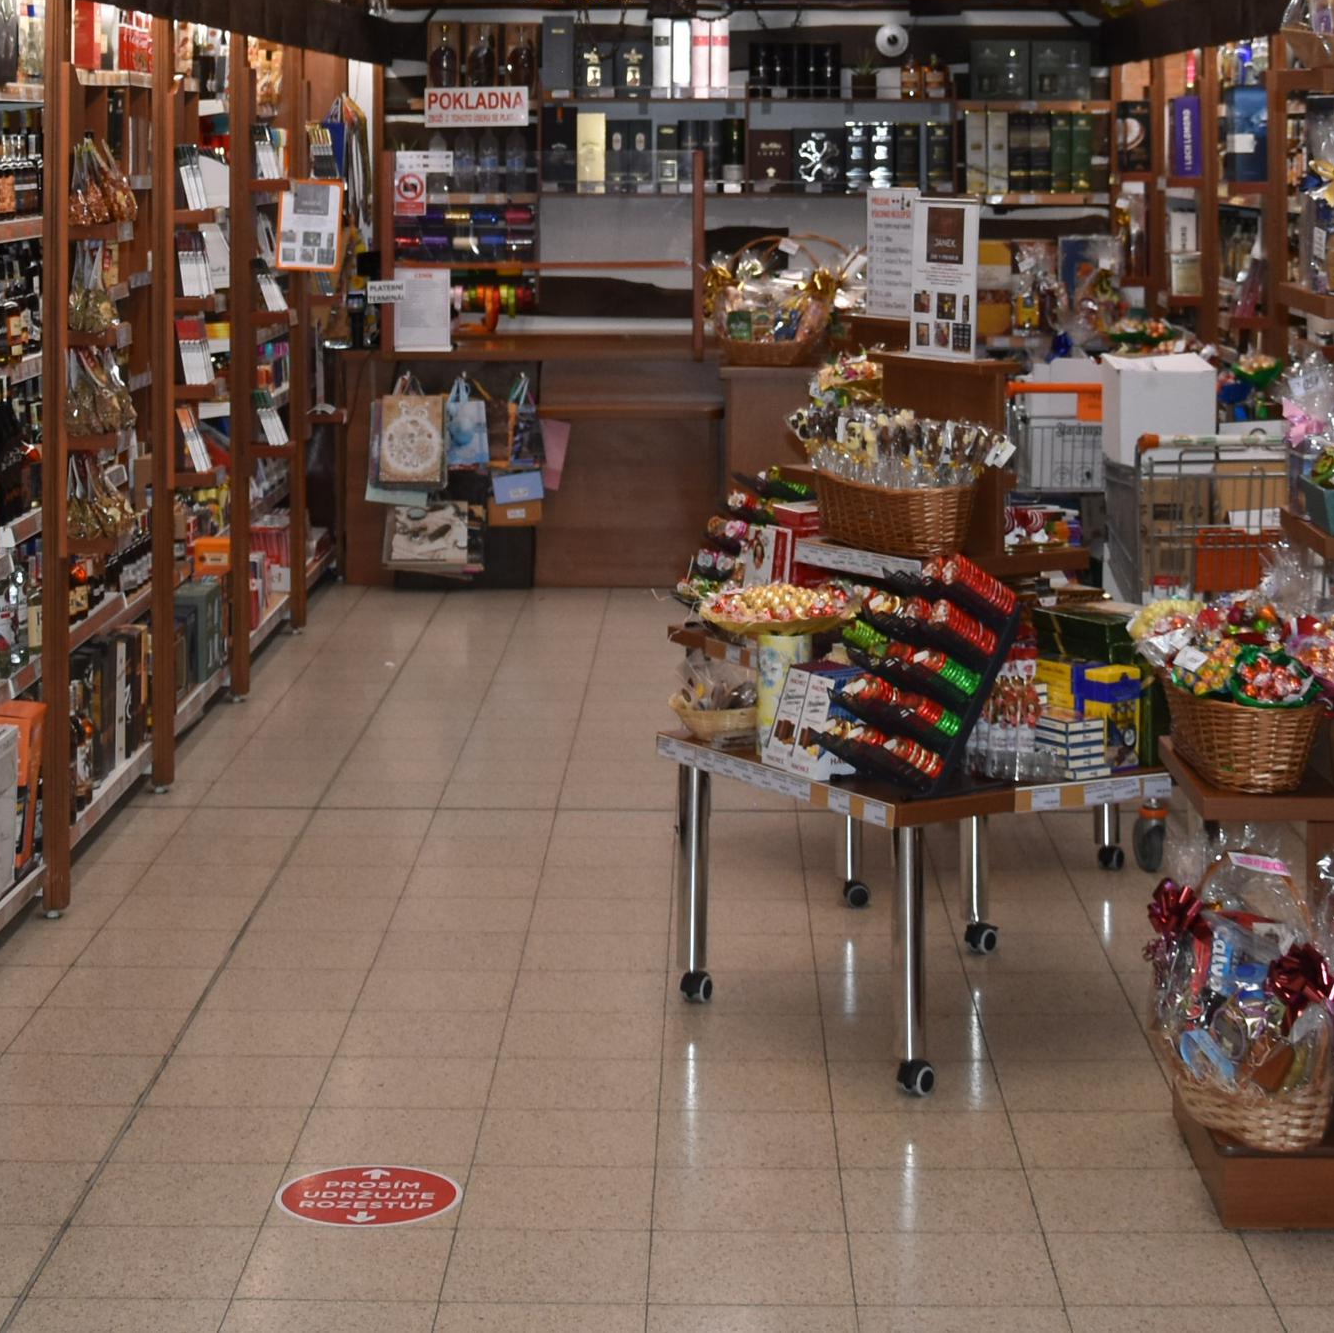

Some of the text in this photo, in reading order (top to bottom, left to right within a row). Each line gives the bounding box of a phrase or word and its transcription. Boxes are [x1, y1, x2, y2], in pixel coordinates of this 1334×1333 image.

[428, 91, 524, 110] POKLADNA
[325, 1179, 419, 1189] PROSÍM
[304, 1189, 436, 1199] UDRŽUJTE
[299, 1200, 433, 1209] ROZESTUP
